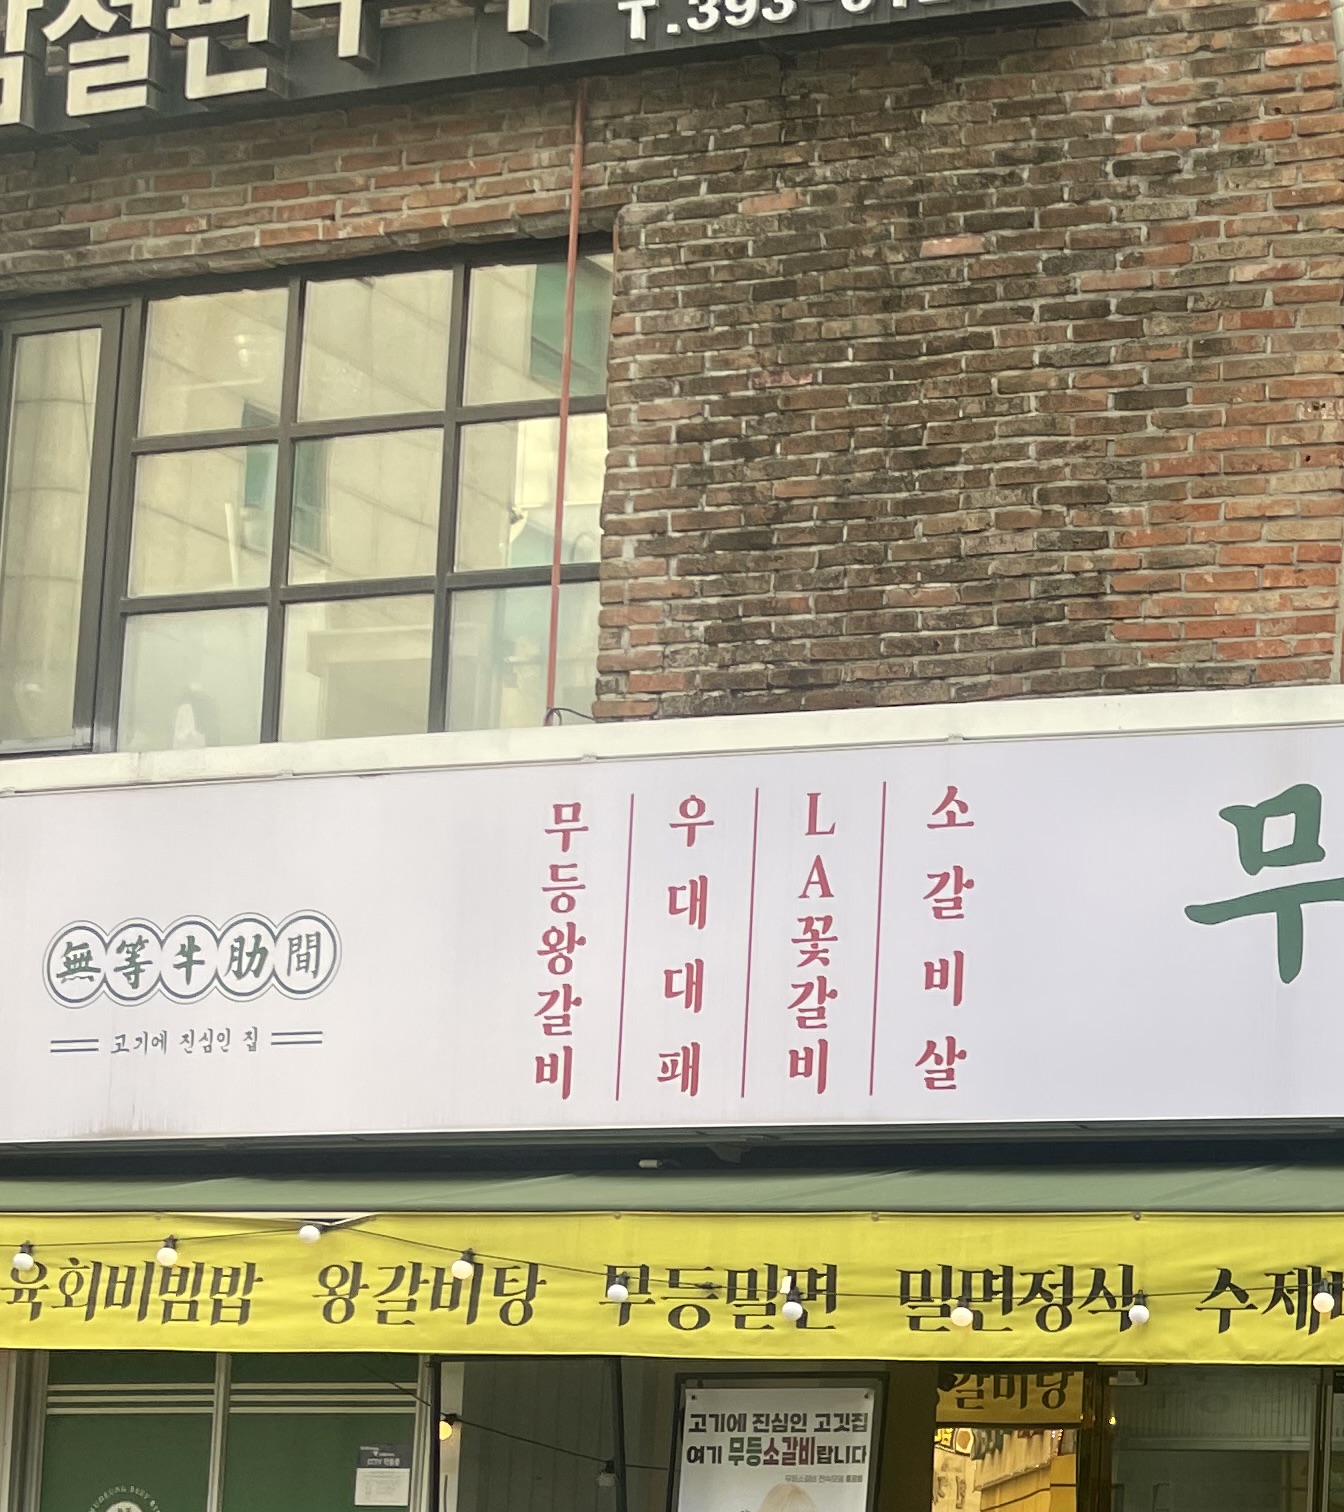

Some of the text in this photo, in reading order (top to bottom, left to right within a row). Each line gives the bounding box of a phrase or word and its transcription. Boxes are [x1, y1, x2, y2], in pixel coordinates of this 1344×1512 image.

[533, 802, 589, 1101] 무등왕갈비
[657, 793, 716, 1098] 우대대패
[786, 791, 840, 1096] LA꽃갈비
[914, 786, 976, 1091] 소갈비살
[111, 1025, 260, 1056] 고기에 진심인 집
[2, 1256, 264, 1326] 육회비빔밥
[313, 1260, 548, 1327] 왕갈비탕
[896, 1263, 1136, 1333] 밀면정식
[686, 1436, 867, 1466] 여기 무등소갈비랍니다
[688, 1413, 868, 1433] 고기에 진심인 고깃집
